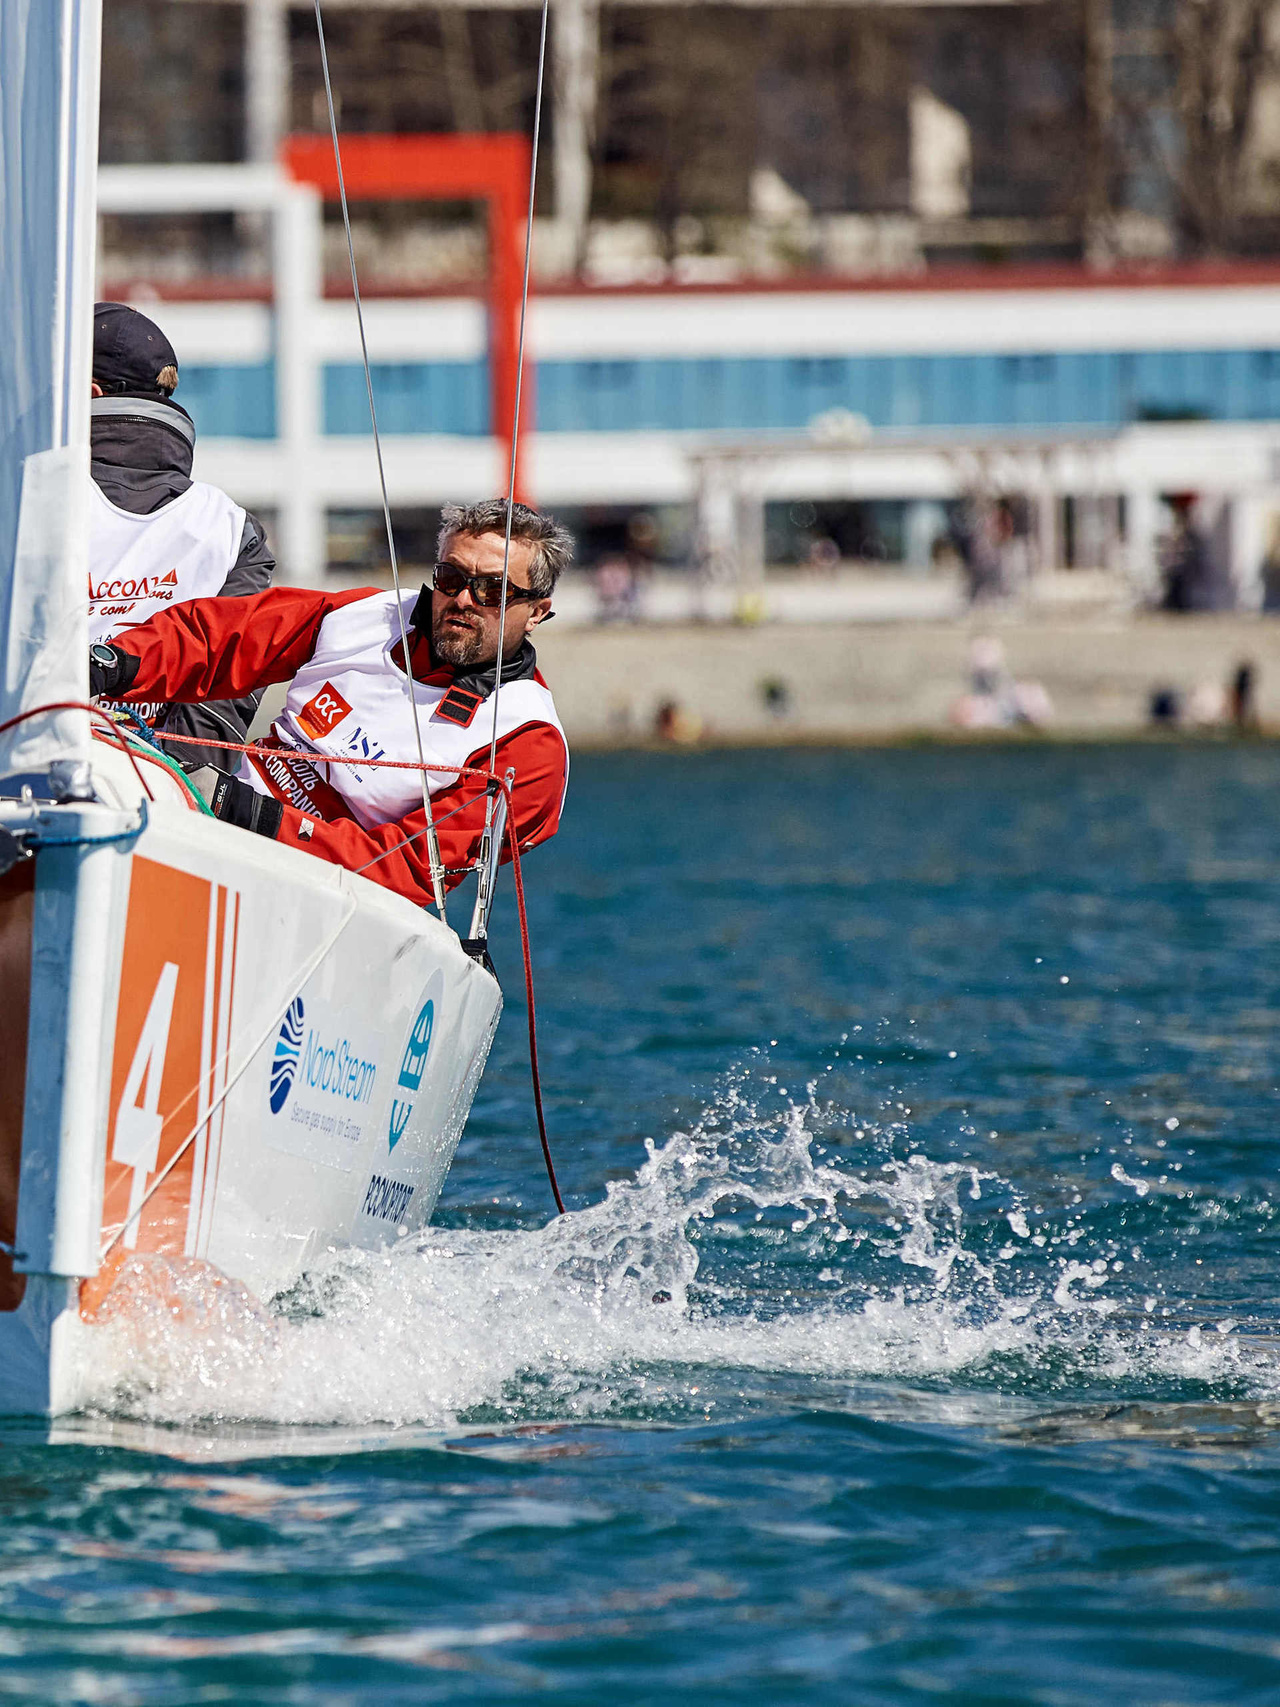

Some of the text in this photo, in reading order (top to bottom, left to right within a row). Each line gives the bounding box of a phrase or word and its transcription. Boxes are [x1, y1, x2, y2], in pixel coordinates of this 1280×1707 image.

[265, 754, 323, 821] COMPANIO
[299, 1029, 377, 1104] Nord Stream
[111, 961, 180, 1250] 4
